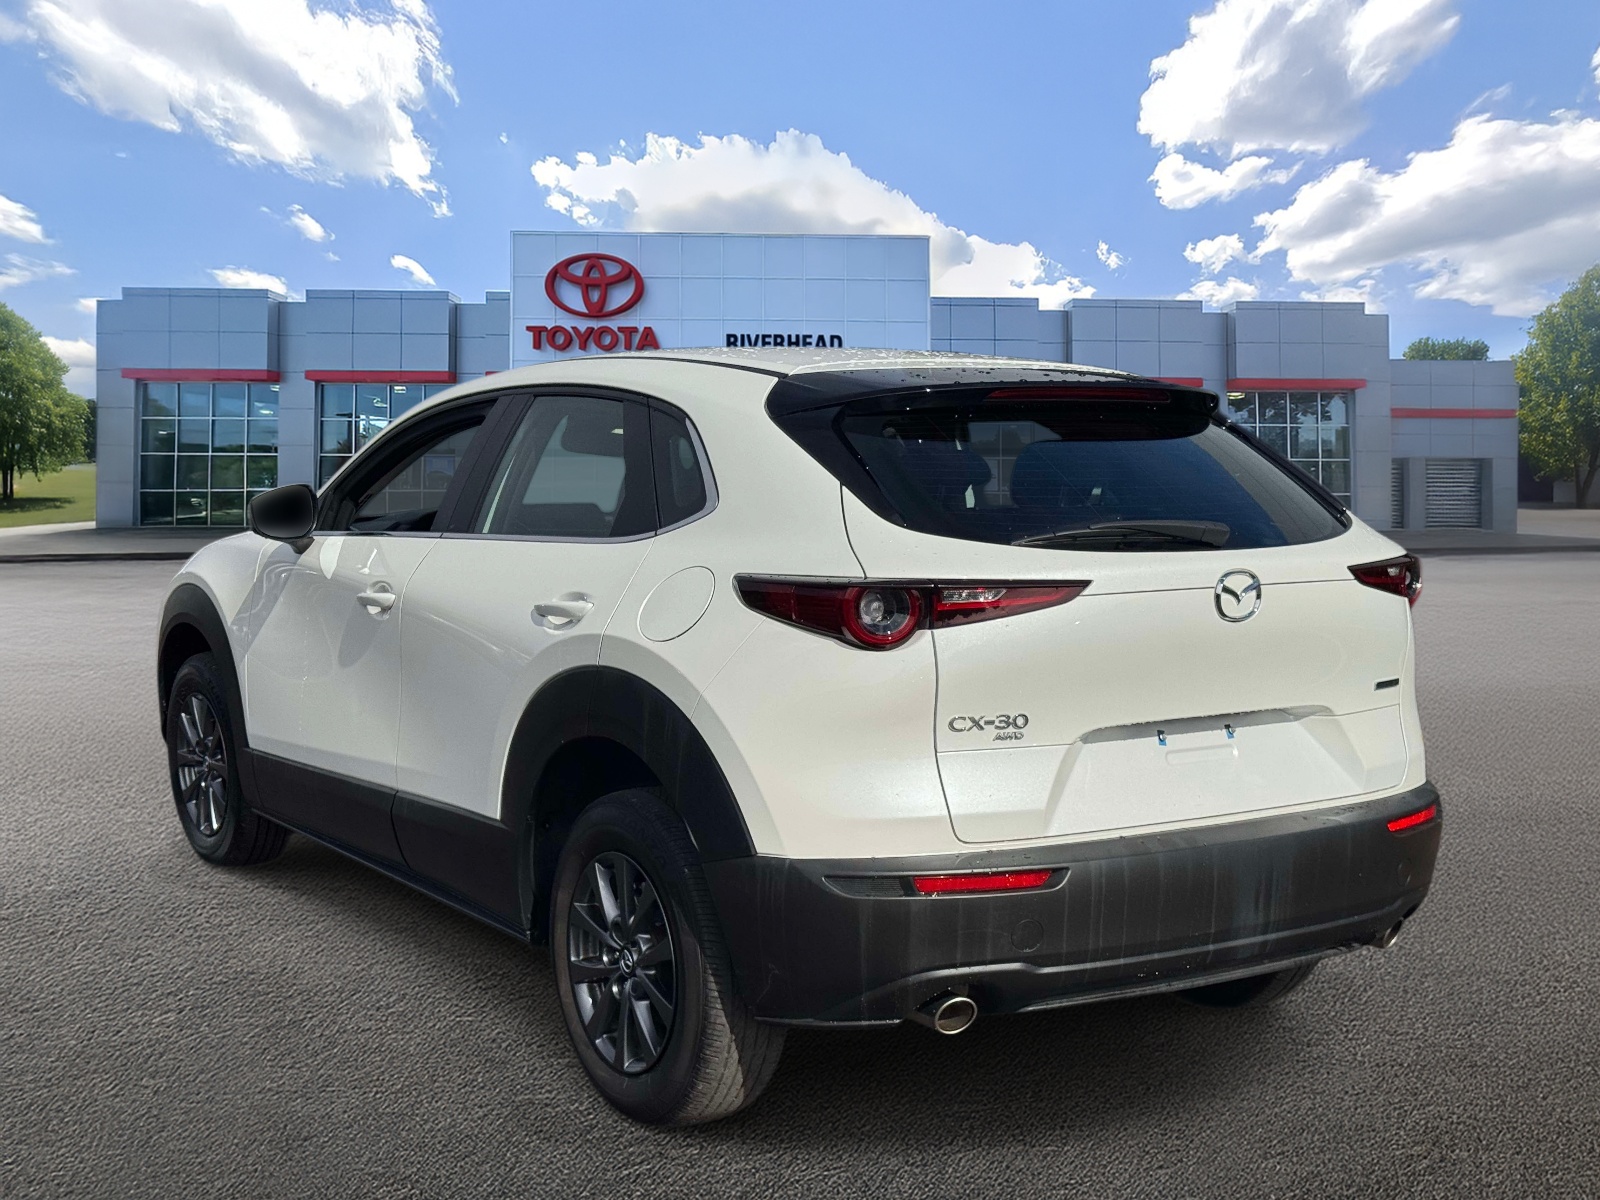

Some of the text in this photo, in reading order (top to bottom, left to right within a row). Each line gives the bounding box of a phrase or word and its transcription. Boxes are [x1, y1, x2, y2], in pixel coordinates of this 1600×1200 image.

[526, 326, 661, 351] TOYOTA
[726, 333, 843, 348] RIVERHEAD
[947, 713, 1029, 732] CX-30
[992, 731, 1024, 741] AWD
